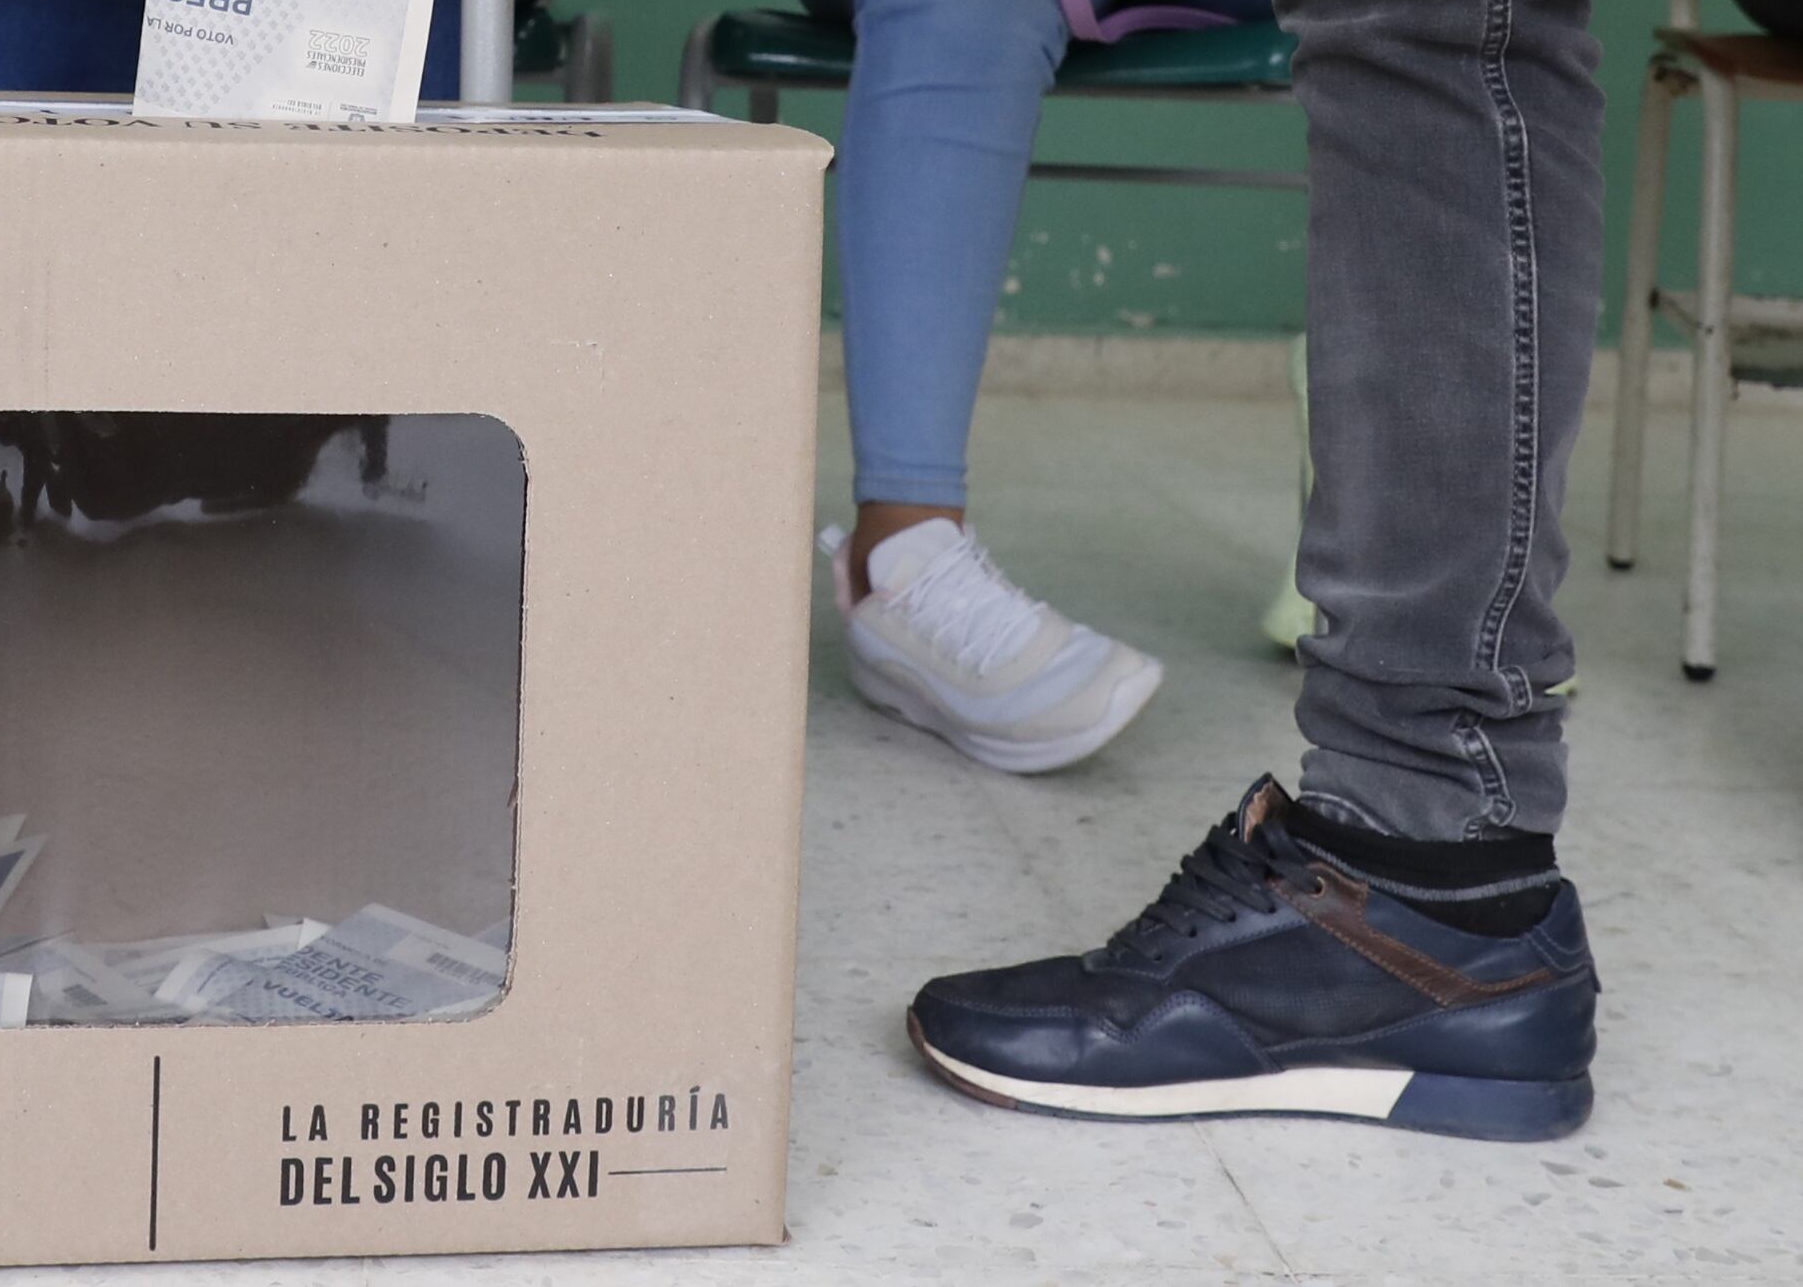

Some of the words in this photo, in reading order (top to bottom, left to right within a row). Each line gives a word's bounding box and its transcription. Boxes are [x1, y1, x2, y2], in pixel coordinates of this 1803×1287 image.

[146, 15, 161, 30] LA
[164, 21, 193, 37] POR
[197, 28, 234, 45] VOTO
[308, 29, 370, 57] 2022
[306, 51, 366, 68] PRESIDENCIALES
[317, 61, 365, 77] ELECCIONES
[184, 120, 262, 131] SU
[281, 1104, 329, 1142] LA
[360, 1085, 730, 1142] REGISTRADURÍA
[279, 1156, 360, 1206] DEL
[373, 1152, 508, 1205] SIGLO
[527, 1150, 600, 1199] XXI
